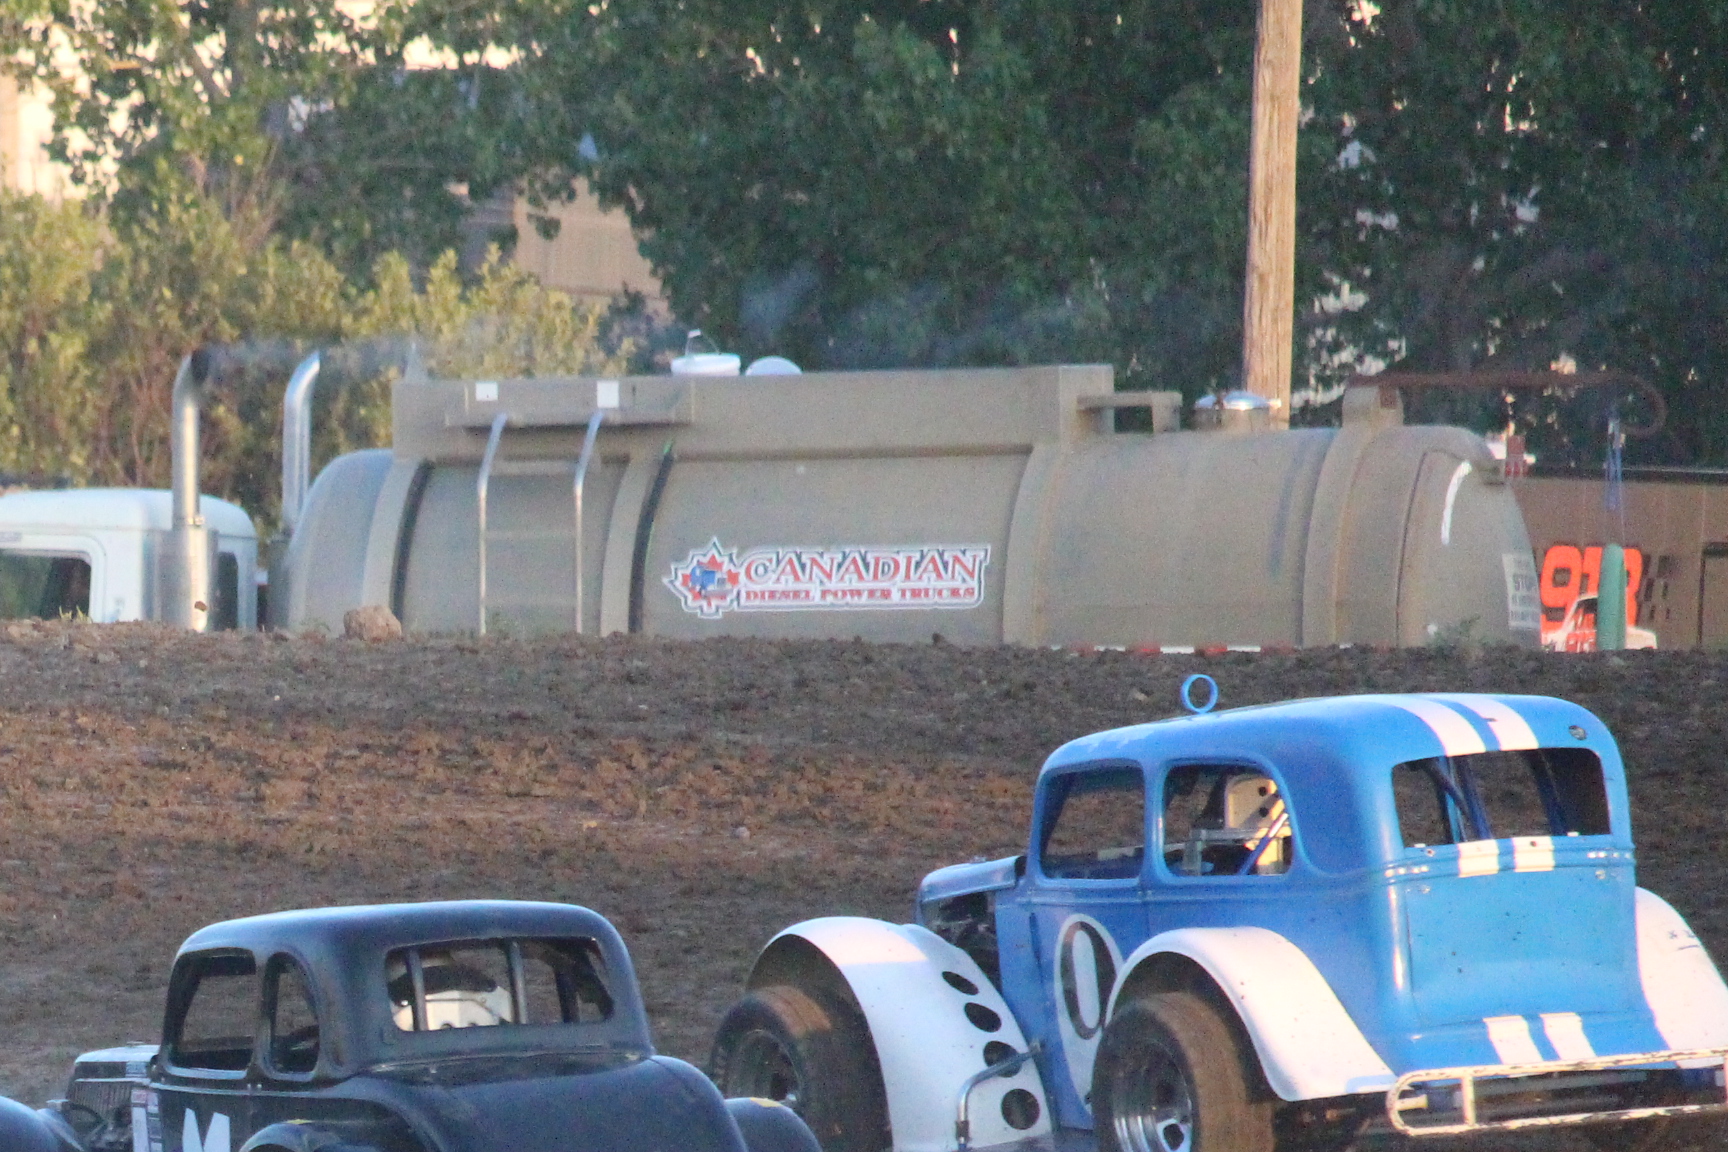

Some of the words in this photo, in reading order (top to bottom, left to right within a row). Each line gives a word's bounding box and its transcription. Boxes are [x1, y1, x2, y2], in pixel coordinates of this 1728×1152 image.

[744, 554, 977, 584] CANADIAN
[745, 590, 813, 600] DIESEL
[822, 589, 892, 599] POWER
[900, 588, 975, 599] TRUCKS
